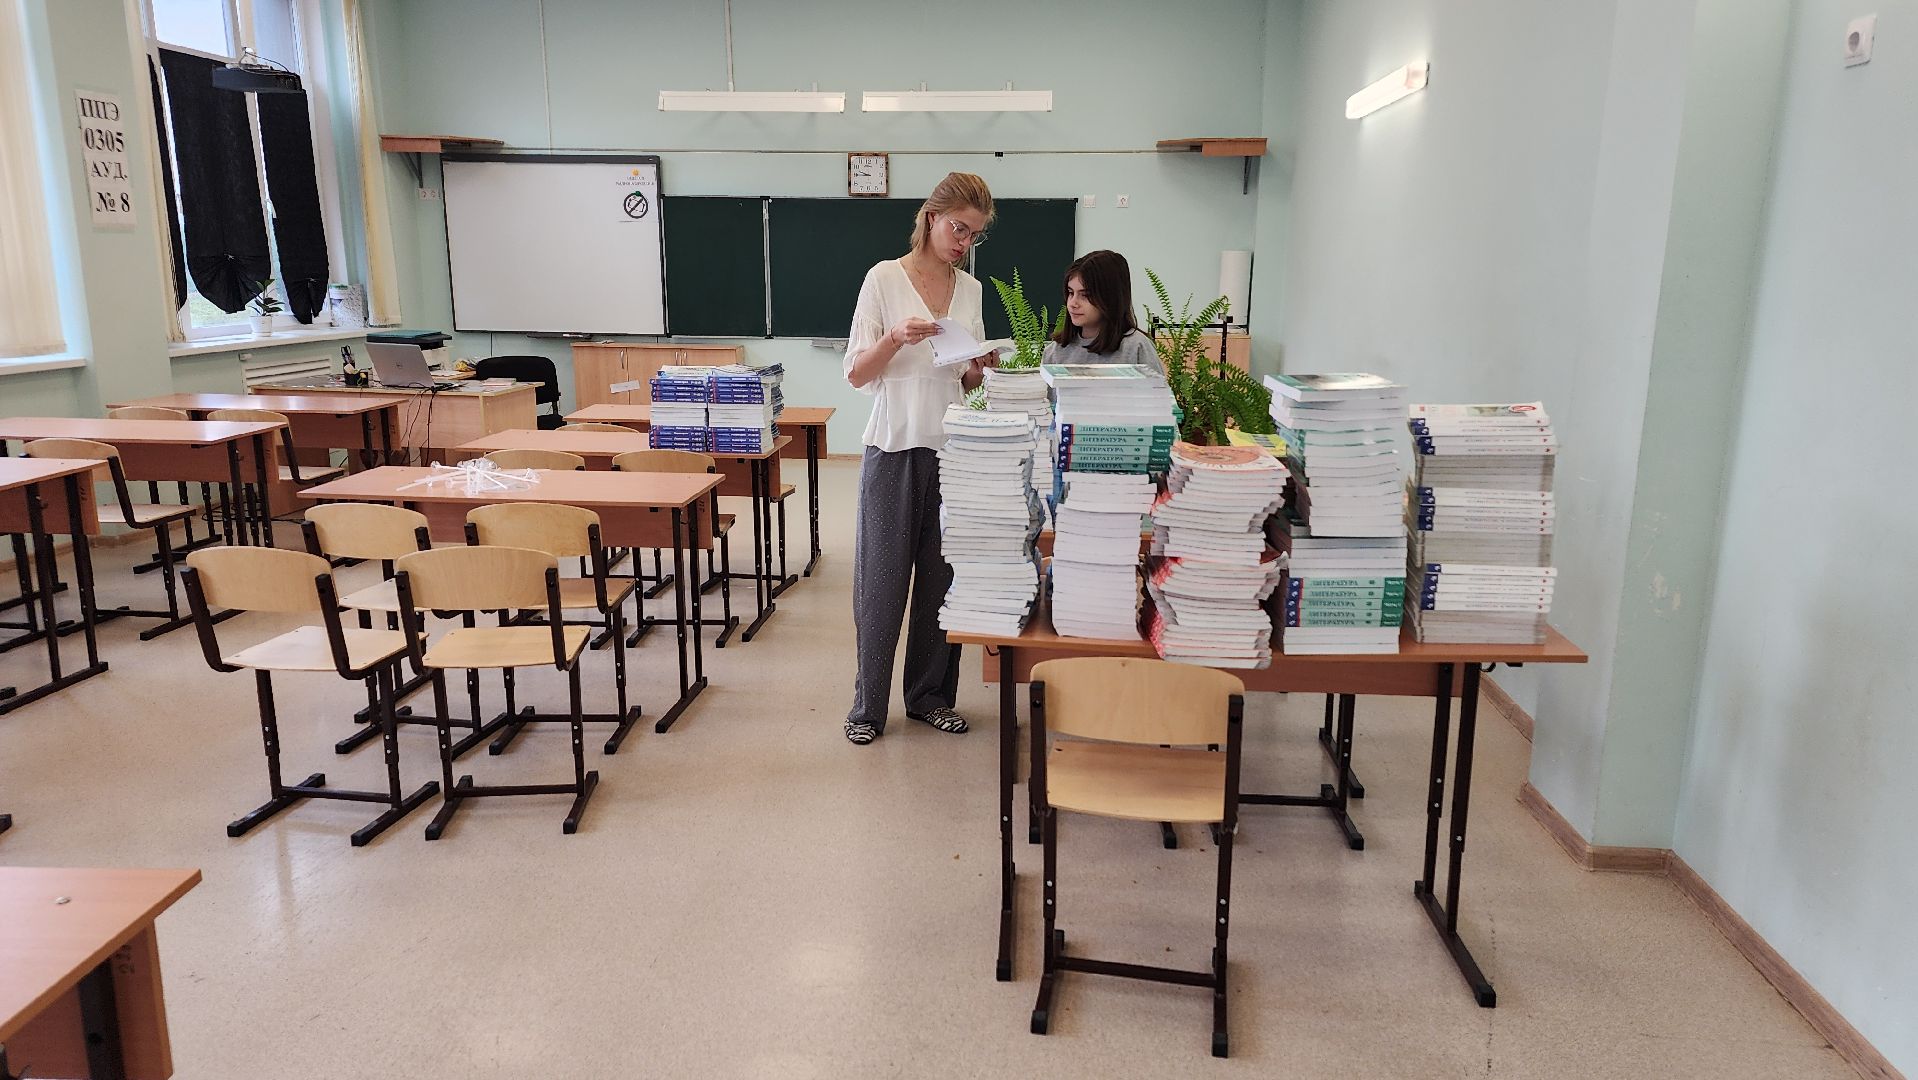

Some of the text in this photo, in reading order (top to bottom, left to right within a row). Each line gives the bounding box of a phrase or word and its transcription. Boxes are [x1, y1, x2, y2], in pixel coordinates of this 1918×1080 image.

[80, 97, 120, 122] ППЭ
[84, 127, 125, 152] 0305
[90, 160, 128, 180] АУД.
[96, 191, 131, 213] № 8
